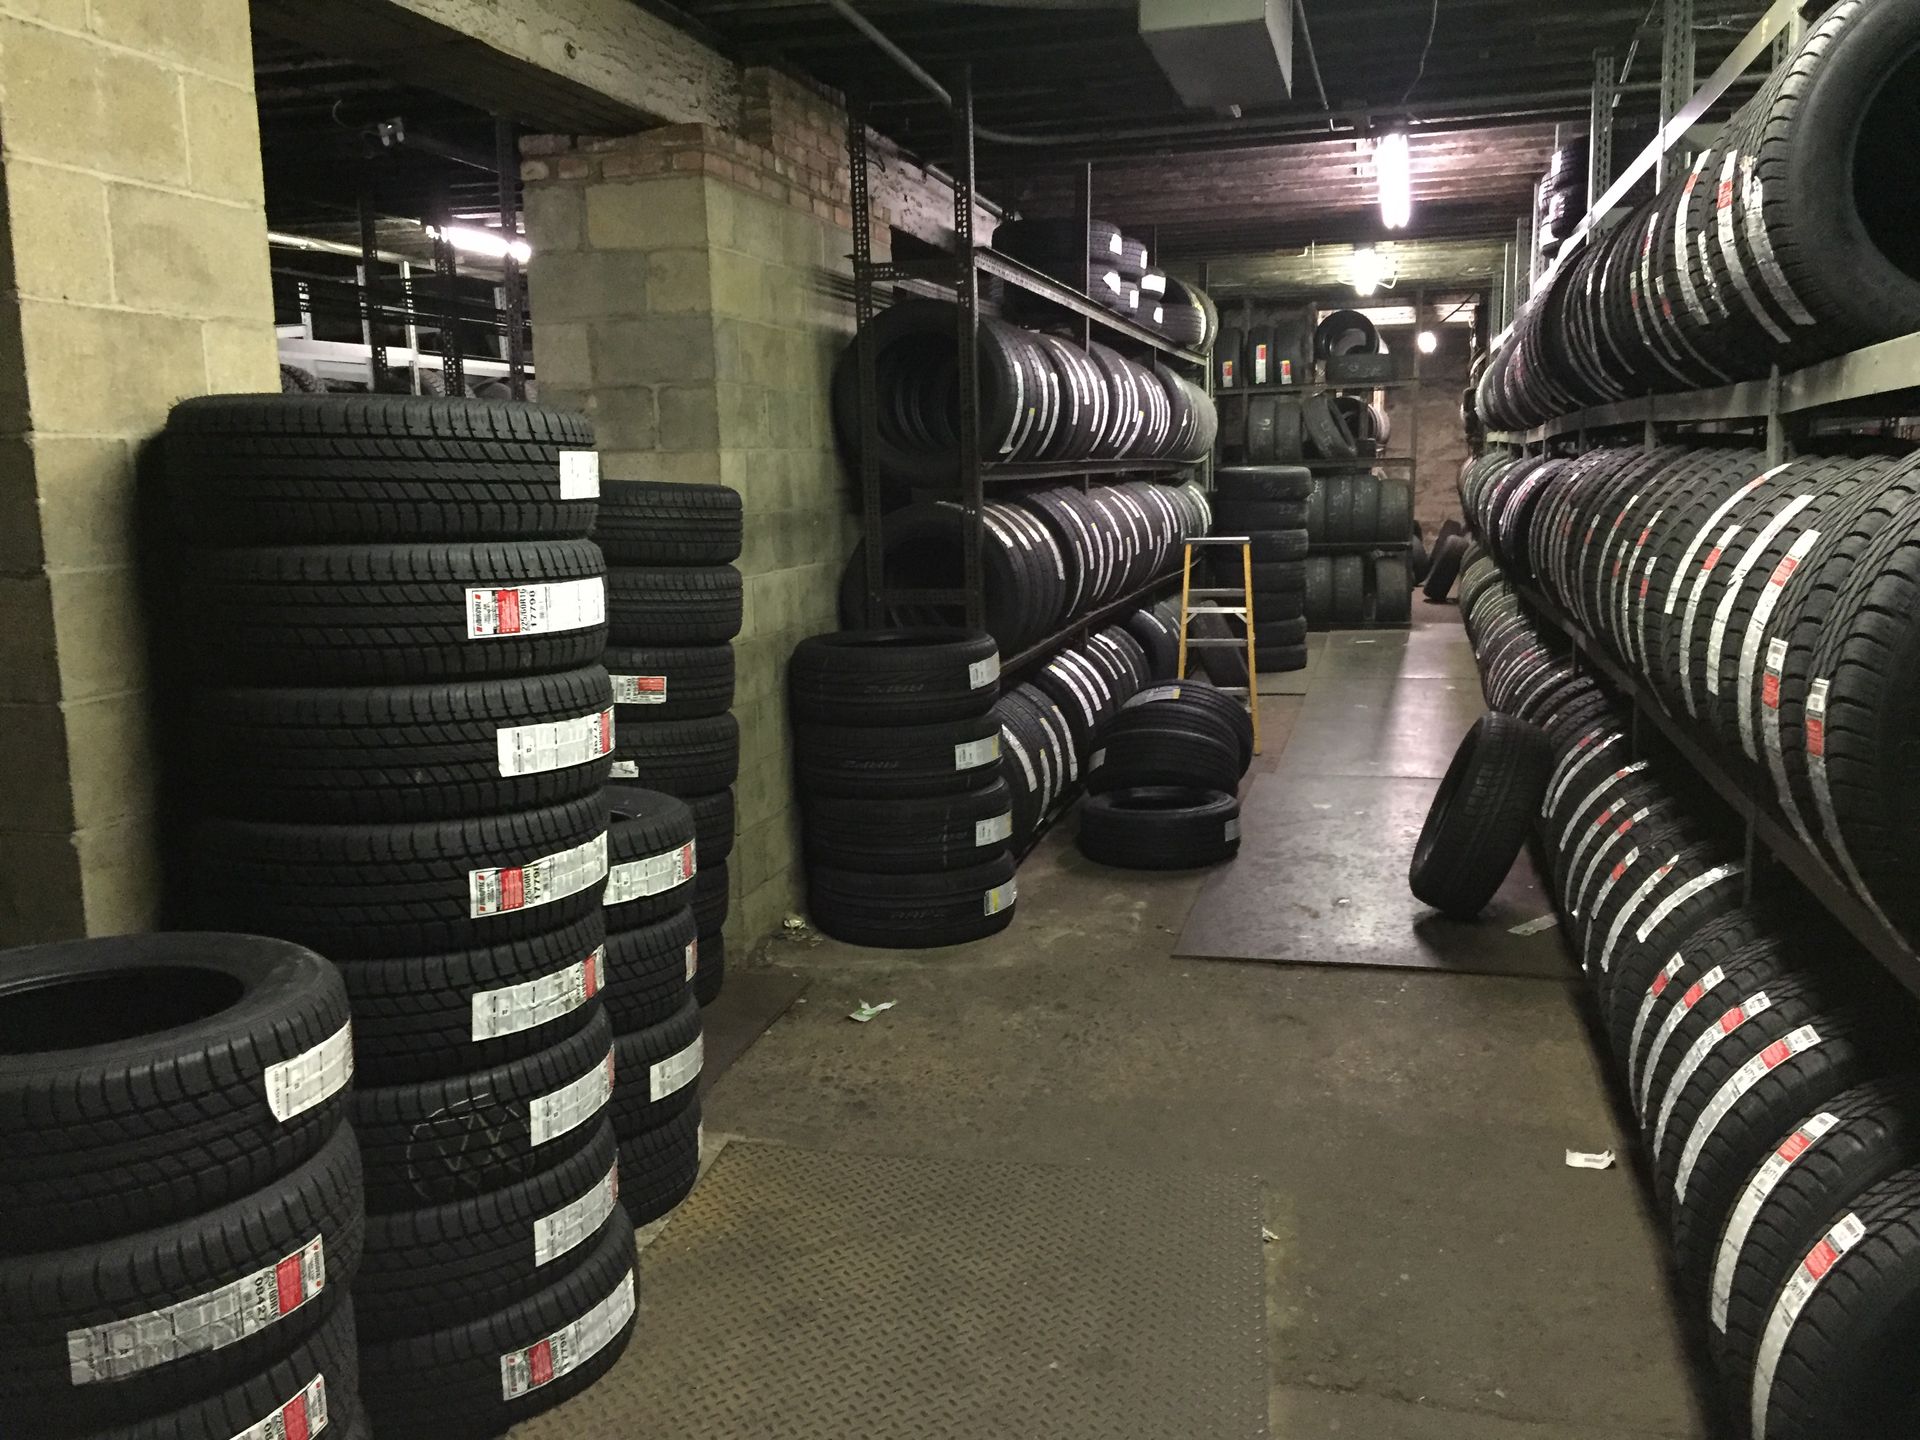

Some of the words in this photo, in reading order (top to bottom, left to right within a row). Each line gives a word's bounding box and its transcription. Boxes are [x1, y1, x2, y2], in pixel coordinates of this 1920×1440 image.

[519, 588, 528, 632] 225/60R16
[529, 590, 537, 627] 17798
[255, 1277, 267, 1322] 08427
